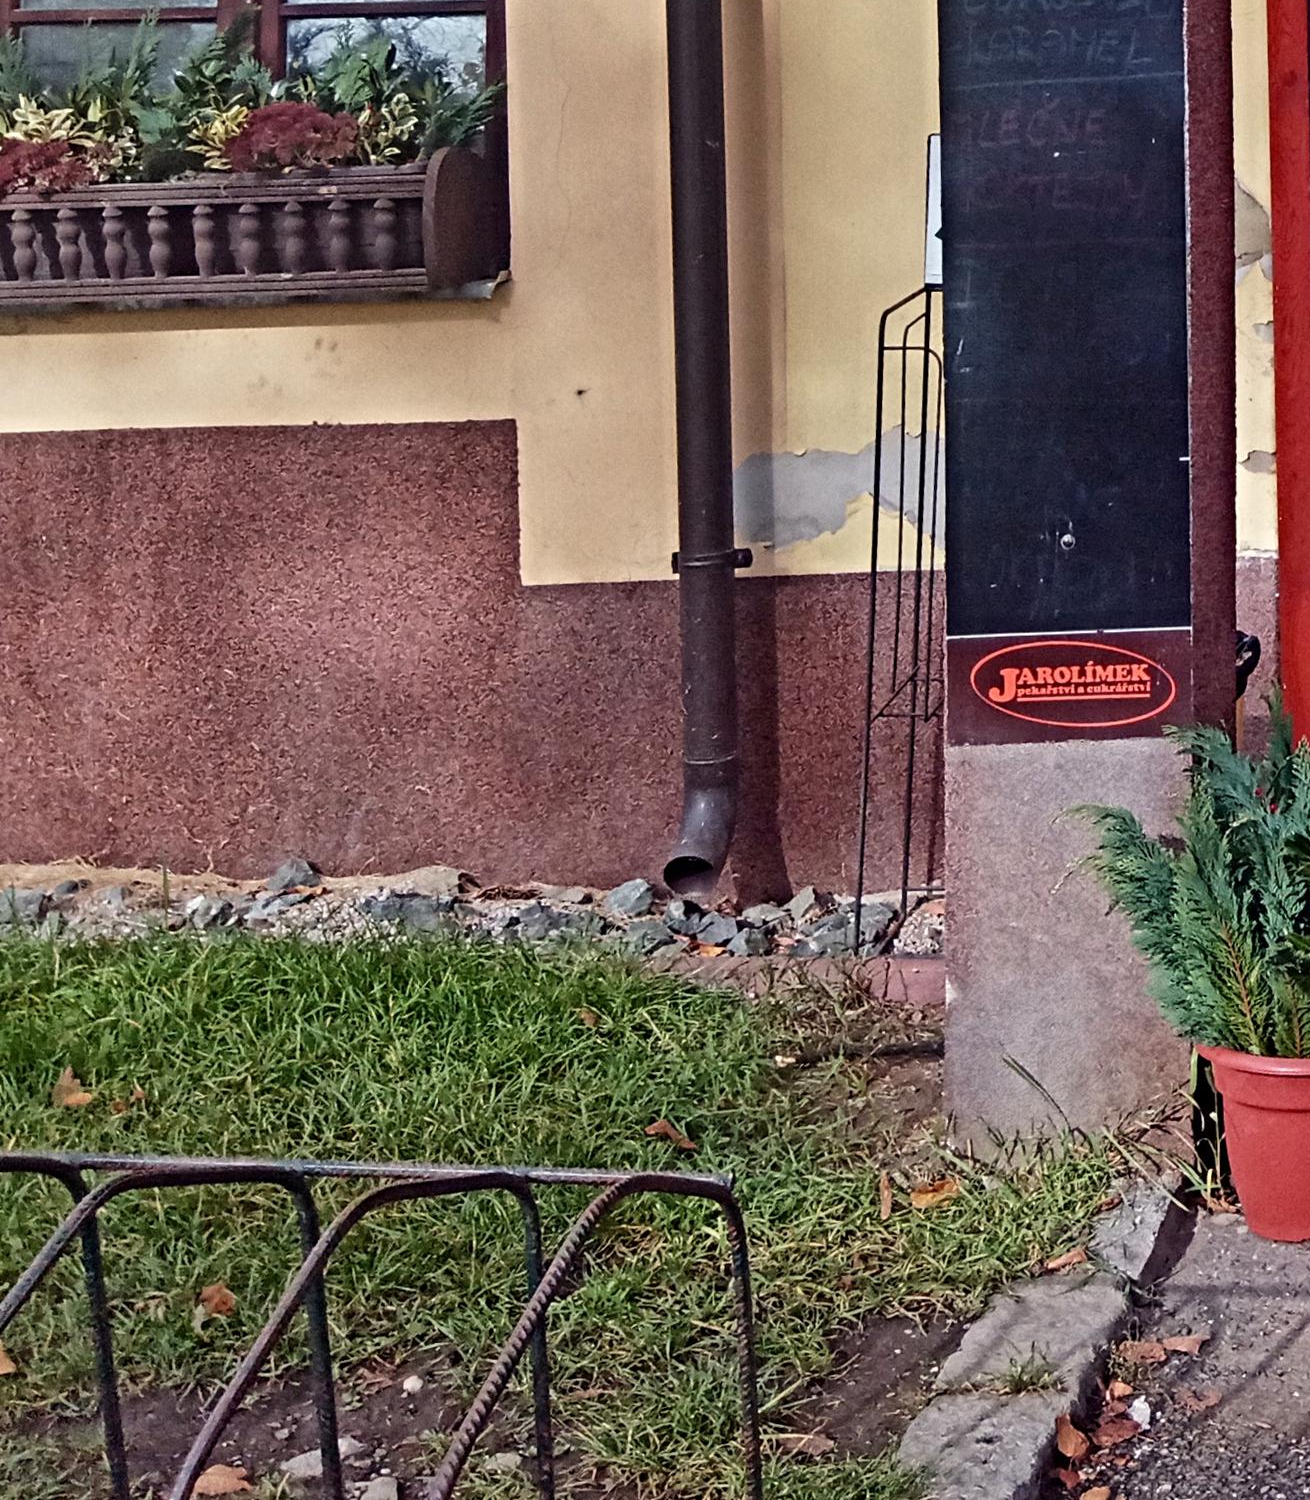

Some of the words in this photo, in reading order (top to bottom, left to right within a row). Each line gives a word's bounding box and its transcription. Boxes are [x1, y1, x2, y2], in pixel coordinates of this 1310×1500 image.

[988, 661, 1151, 703] JAROLÍMEK
[1017, 684, 1075, 697] pekařství
[1087, 681, 1151, 693] cukrářství
